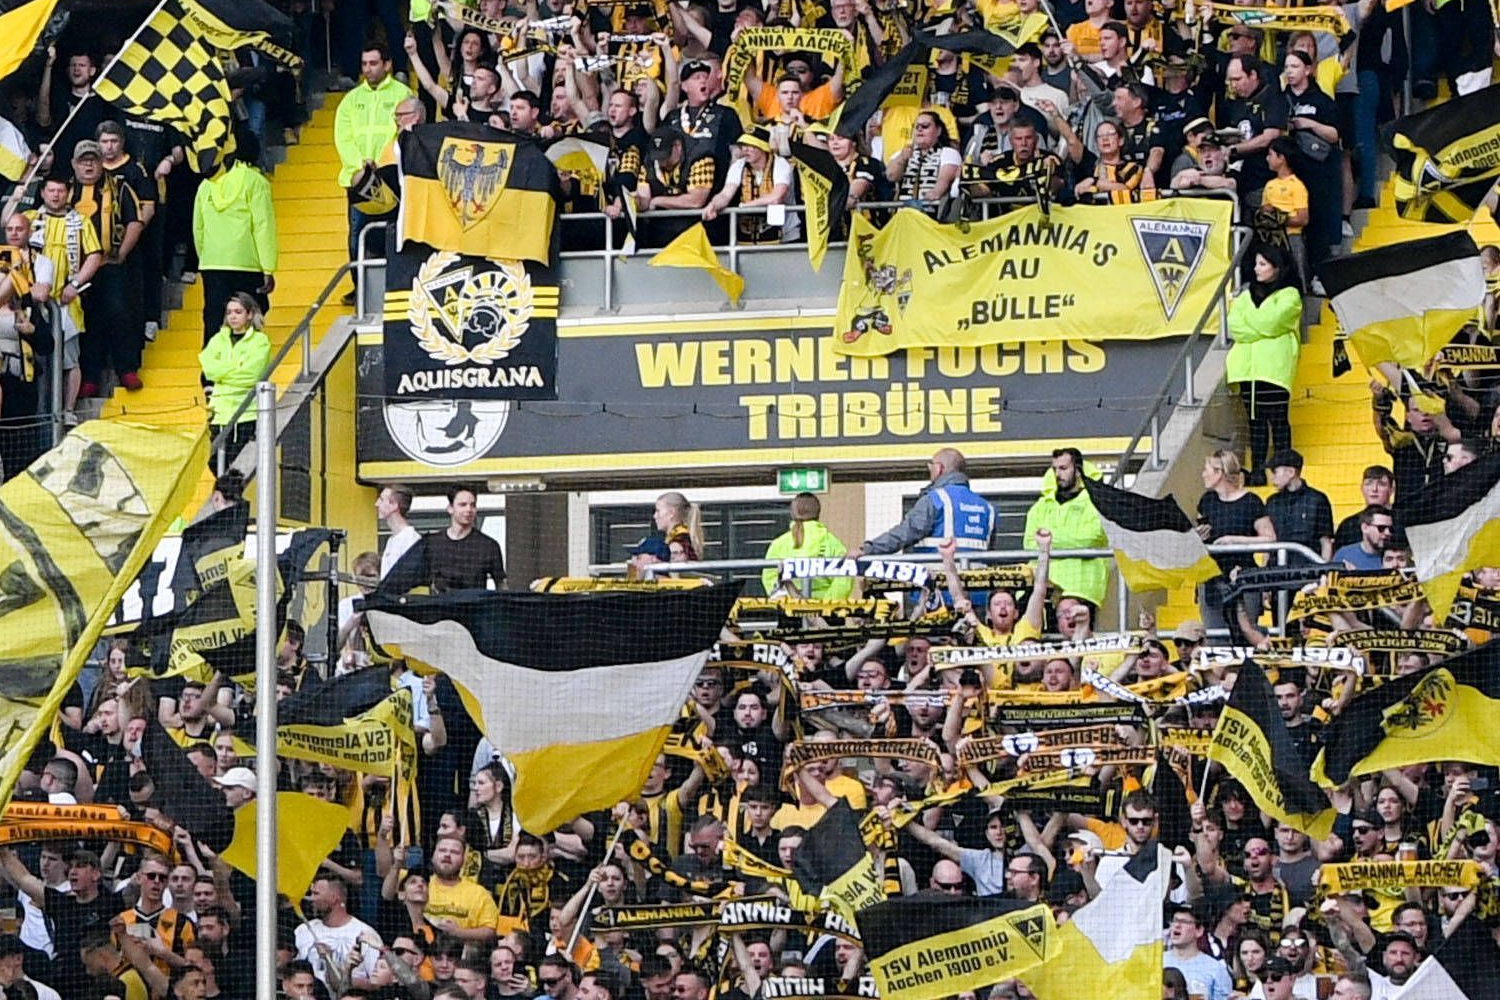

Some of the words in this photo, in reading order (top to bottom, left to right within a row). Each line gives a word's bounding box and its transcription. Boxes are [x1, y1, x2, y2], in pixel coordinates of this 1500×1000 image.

[999, 257, 1041, 281] AU
[397, 365, 545, 395] AQUISGRANA
[740, 382, 1002, 441] TRIBÜNE
[1219, 716, 1250, 739] TSV
[1336, 862, 1405, 882] ALEMANNIA
[1413, 861, 1464, 880] AACHEN
[617, 903, 705, 923] ALEMANNIA
[880, 956, 912, 979] TSV
[917, 929, 1010, 968] Alemannia
[887, 967, 944, 995] Aachen
[946, 958, 982, 978] 1900
[985, 946, 1016, 967] e.V.
